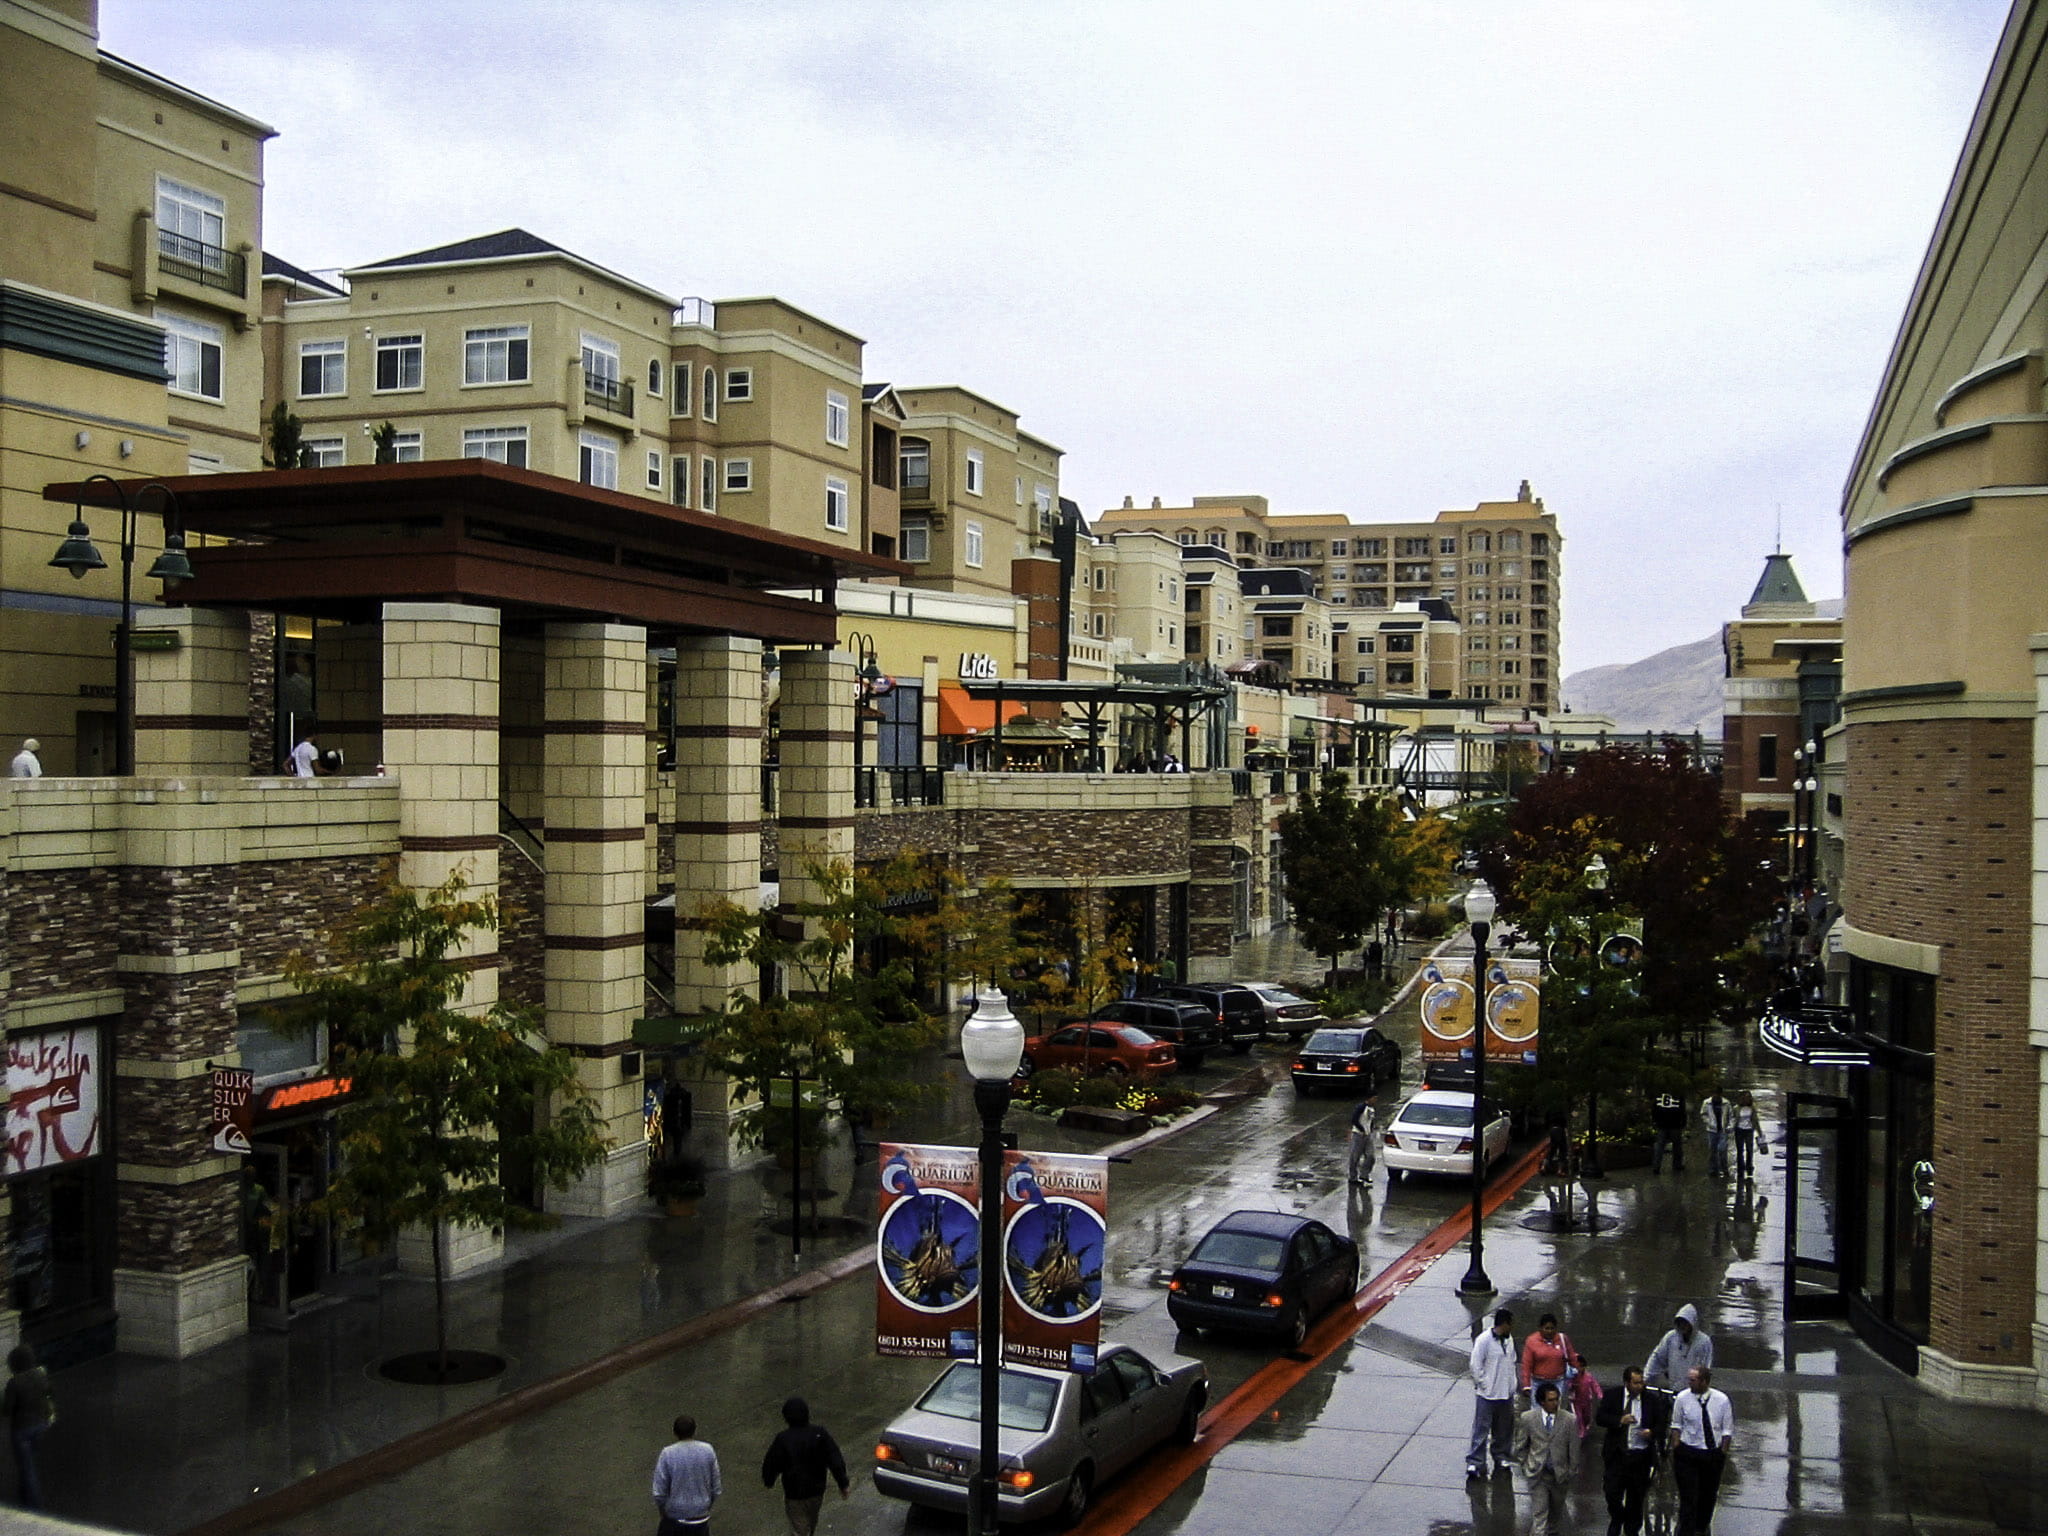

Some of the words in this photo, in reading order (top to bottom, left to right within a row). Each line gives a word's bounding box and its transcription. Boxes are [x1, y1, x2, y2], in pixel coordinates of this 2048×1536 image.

[960, 652, 998, 679] Lids
[214, 1071, 251, 1089] QUIK
[213, 1089, 247, 1107] SILV
[213, 1106, 231, 1122] ER
